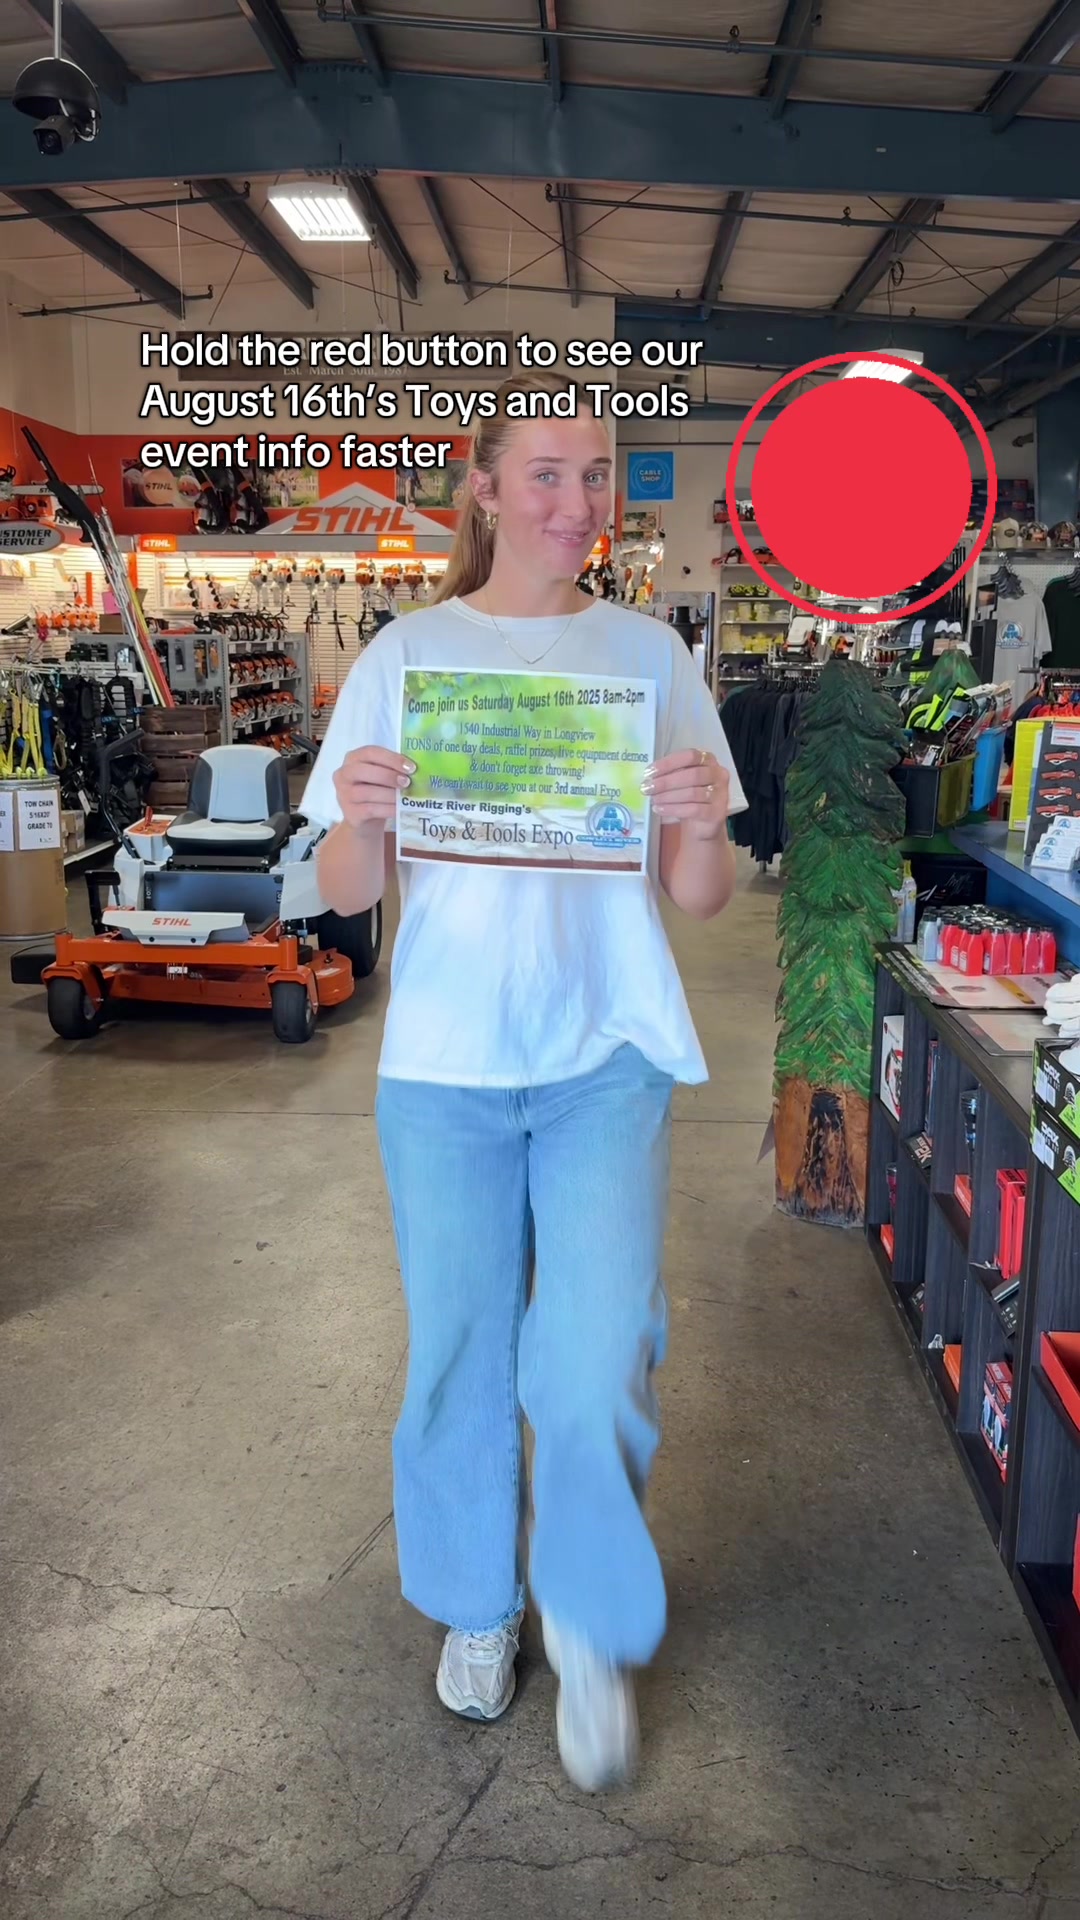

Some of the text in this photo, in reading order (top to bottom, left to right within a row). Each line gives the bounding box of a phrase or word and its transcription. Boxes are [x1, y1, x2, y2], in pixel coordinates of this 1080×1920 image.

[145, 482, 173, 490] STIHL
[292, 507, 415, 533] STIHL
[0, 529, 52, 538] STOMER
[142, 539, 171, 548] STIHL
[381, 539, 409, 548] STIHL
[408, 688, 645, 716] Come join us Saturday August 16th 2025 8am-2pm
[460, 722, 596, 743] 1540 Industrial Way in Longview
[405, 737, 432, 751] TONS
[434, 740, 445, 752] of
[445, 743, 460, 752] one
[462, 741, 477, 756] day
[480, 742, 503, 757] deals,
[505, 744, 527, 756] raffel
[557, 745, 574, 758] live
[576, 747, 620, 763] equipment
[621, 749, 649, 763] demos
[470, 760, 586, 780] & don't forget axe throwing!
[430, 776, 443, 788] We
[465, 780, 484, 790] wait
[485, 780, 494, 791] to
[495, 782, 509, 791] see
[511, 783, 527, 794] you
[529, 783, 537, 793] at
[538, 785, 553, 794] our
[554, 782, 569, 794] 3rd
[570, 784, 598, 796] annual
[600, 784, 621, 799] Expo
[401, 797, 532, 815] Cowlitz River Rigging's
[418, 817, 574, 849] Toys & Tools Expo
[152, 917, 192, 926] STIHL
